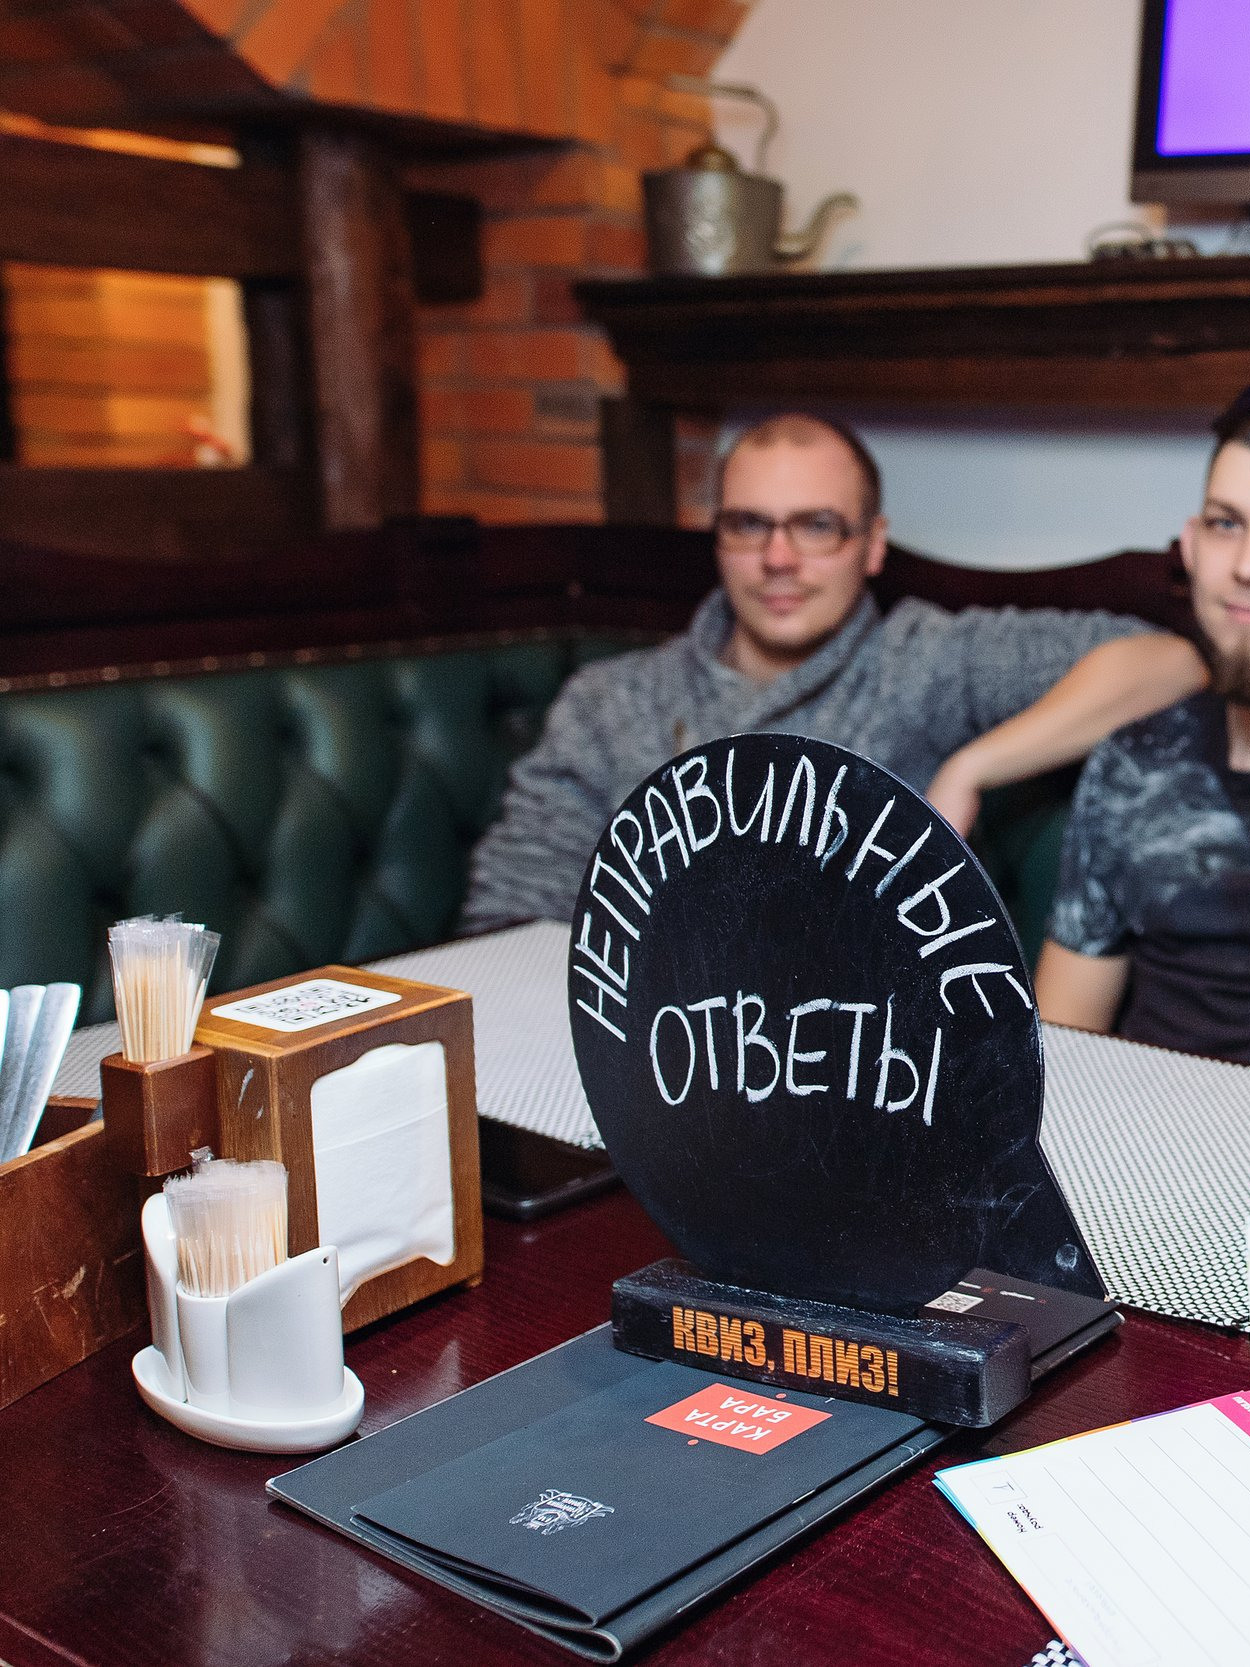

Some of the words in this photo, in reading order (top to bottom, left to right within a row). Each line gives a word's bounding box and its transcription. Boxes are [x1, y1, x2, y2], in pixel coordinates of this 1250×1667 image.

[573, 748, 1034, 1042] НЕПРАВИЛЬНЫЕ
[651, 989, 943, 1127] ОТВЕТЫ
[672, 1305, 775, 1372] КВИЗ,
[782, 1328, 900, 1397] ПЛИЗ!
[683, 1408, 772, 1442] КАРТА
[718, 1395, 793, 1423] БАРА
